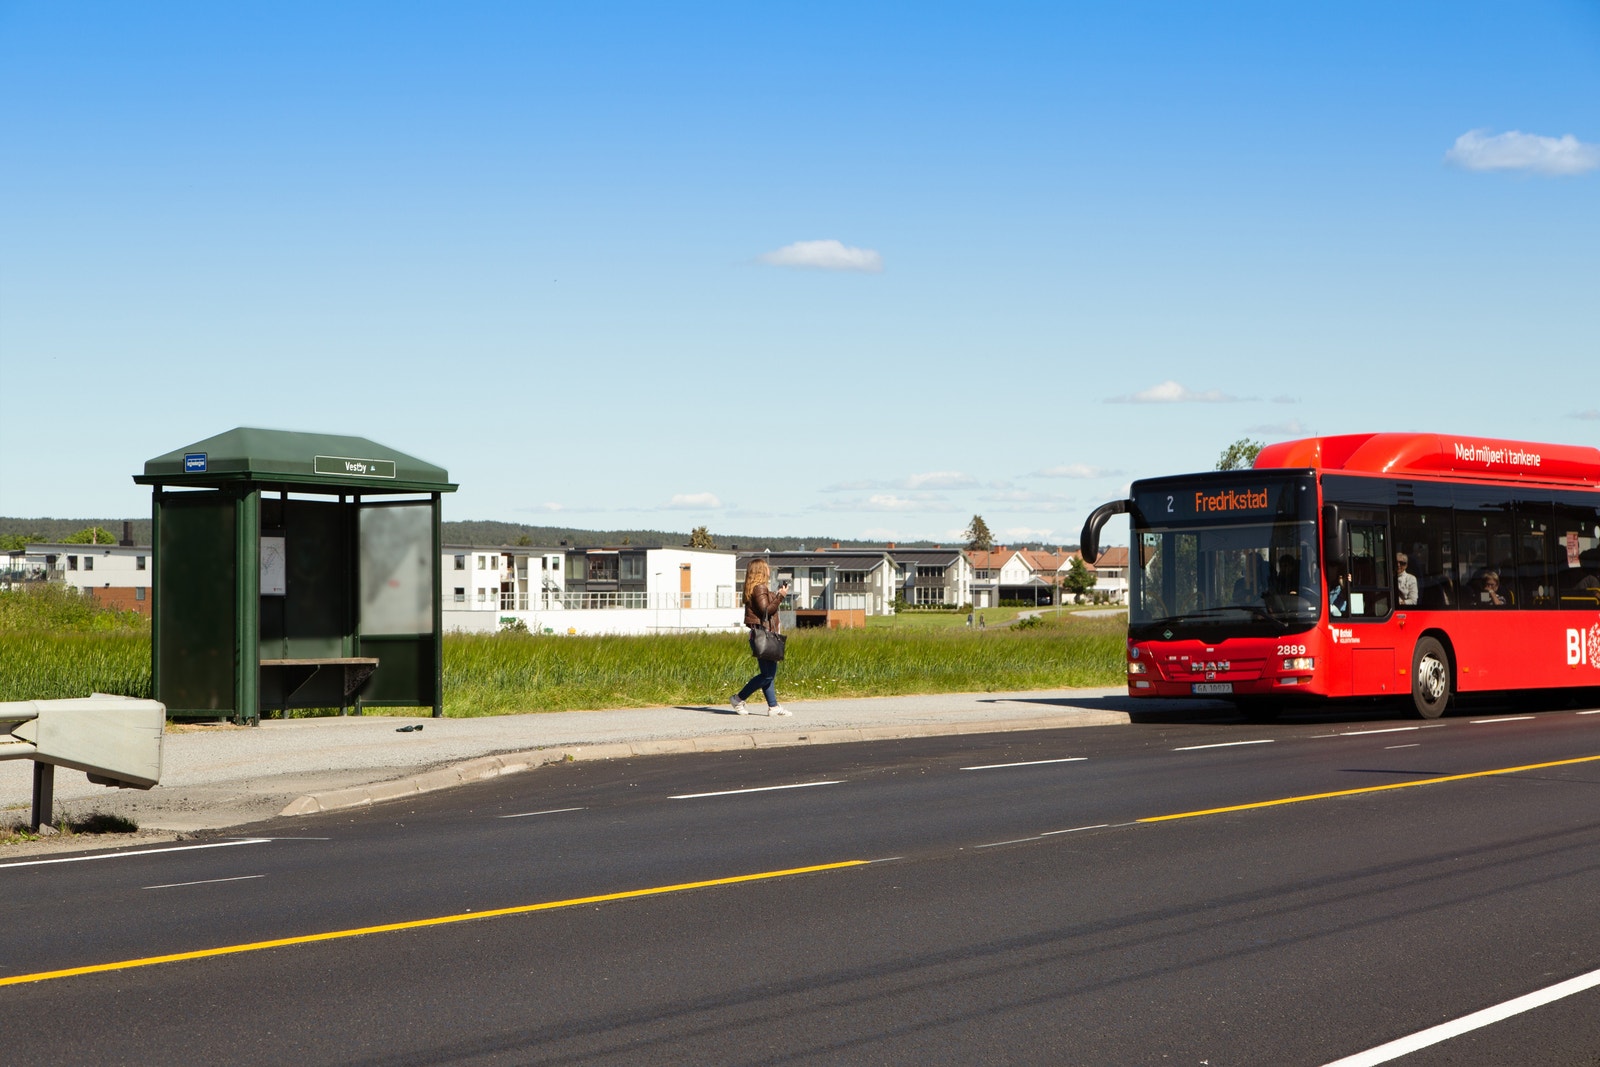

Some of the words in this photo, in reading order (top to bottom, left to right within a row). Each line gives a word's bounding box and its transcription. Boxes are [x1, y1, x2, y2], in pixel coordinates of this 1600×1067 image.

[1454, 443, 1474, 461] Med
[1476, 445, 1504, 467] miljøet
[1504, 448, 1508, 464] i
[1509, 449, 1541, 467] tankene
[345, 461, 367, 474] Vestby
[1167, 495, 1174, 512] 2
[1195, 488, 1268, 512] Fredrikstad
[1277, 644, 1306, 656] 2889
[1191, 661, 1231, 672] MAN
